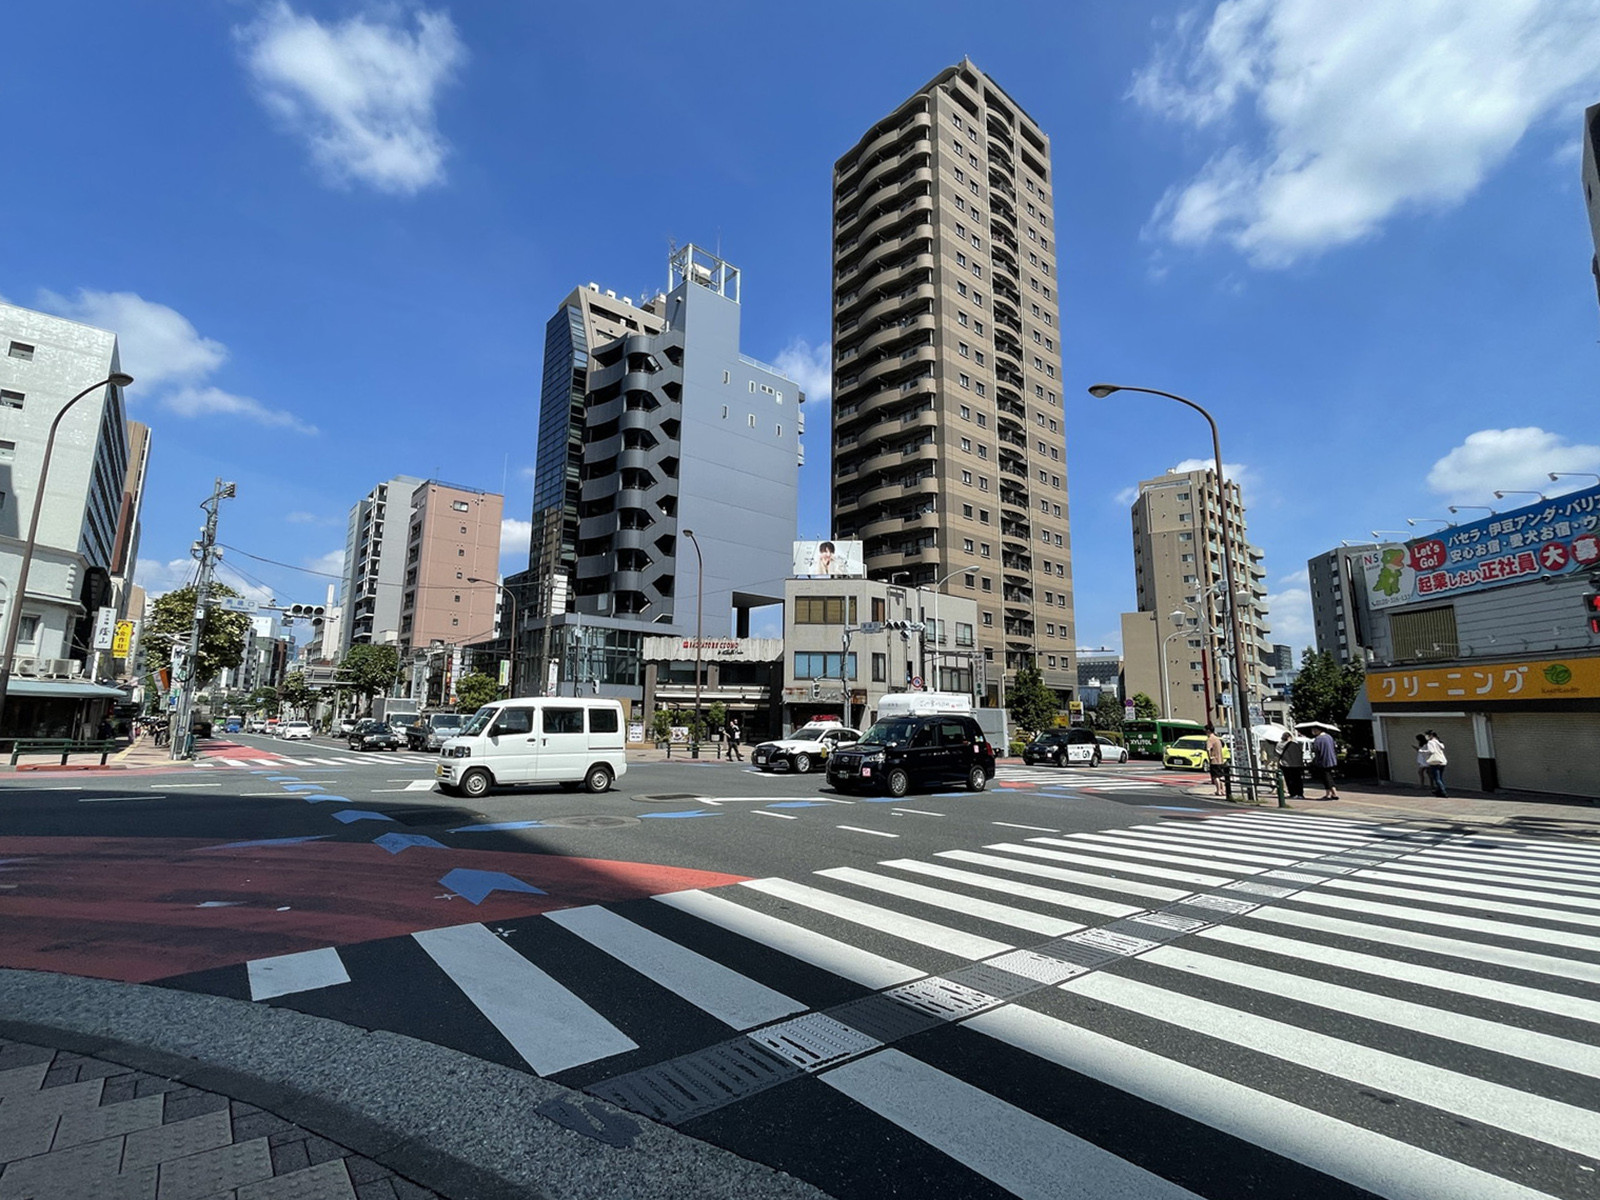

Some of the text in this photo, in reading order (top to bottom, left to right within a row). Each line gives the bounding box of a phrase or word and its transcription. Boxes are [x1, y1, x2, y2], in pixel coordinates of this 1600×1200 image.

[1414, 542, 1440, 557] Let's
[1420, 556, 1438, 568] Go!
[1382, 666, 1529, 698] クリーニング
